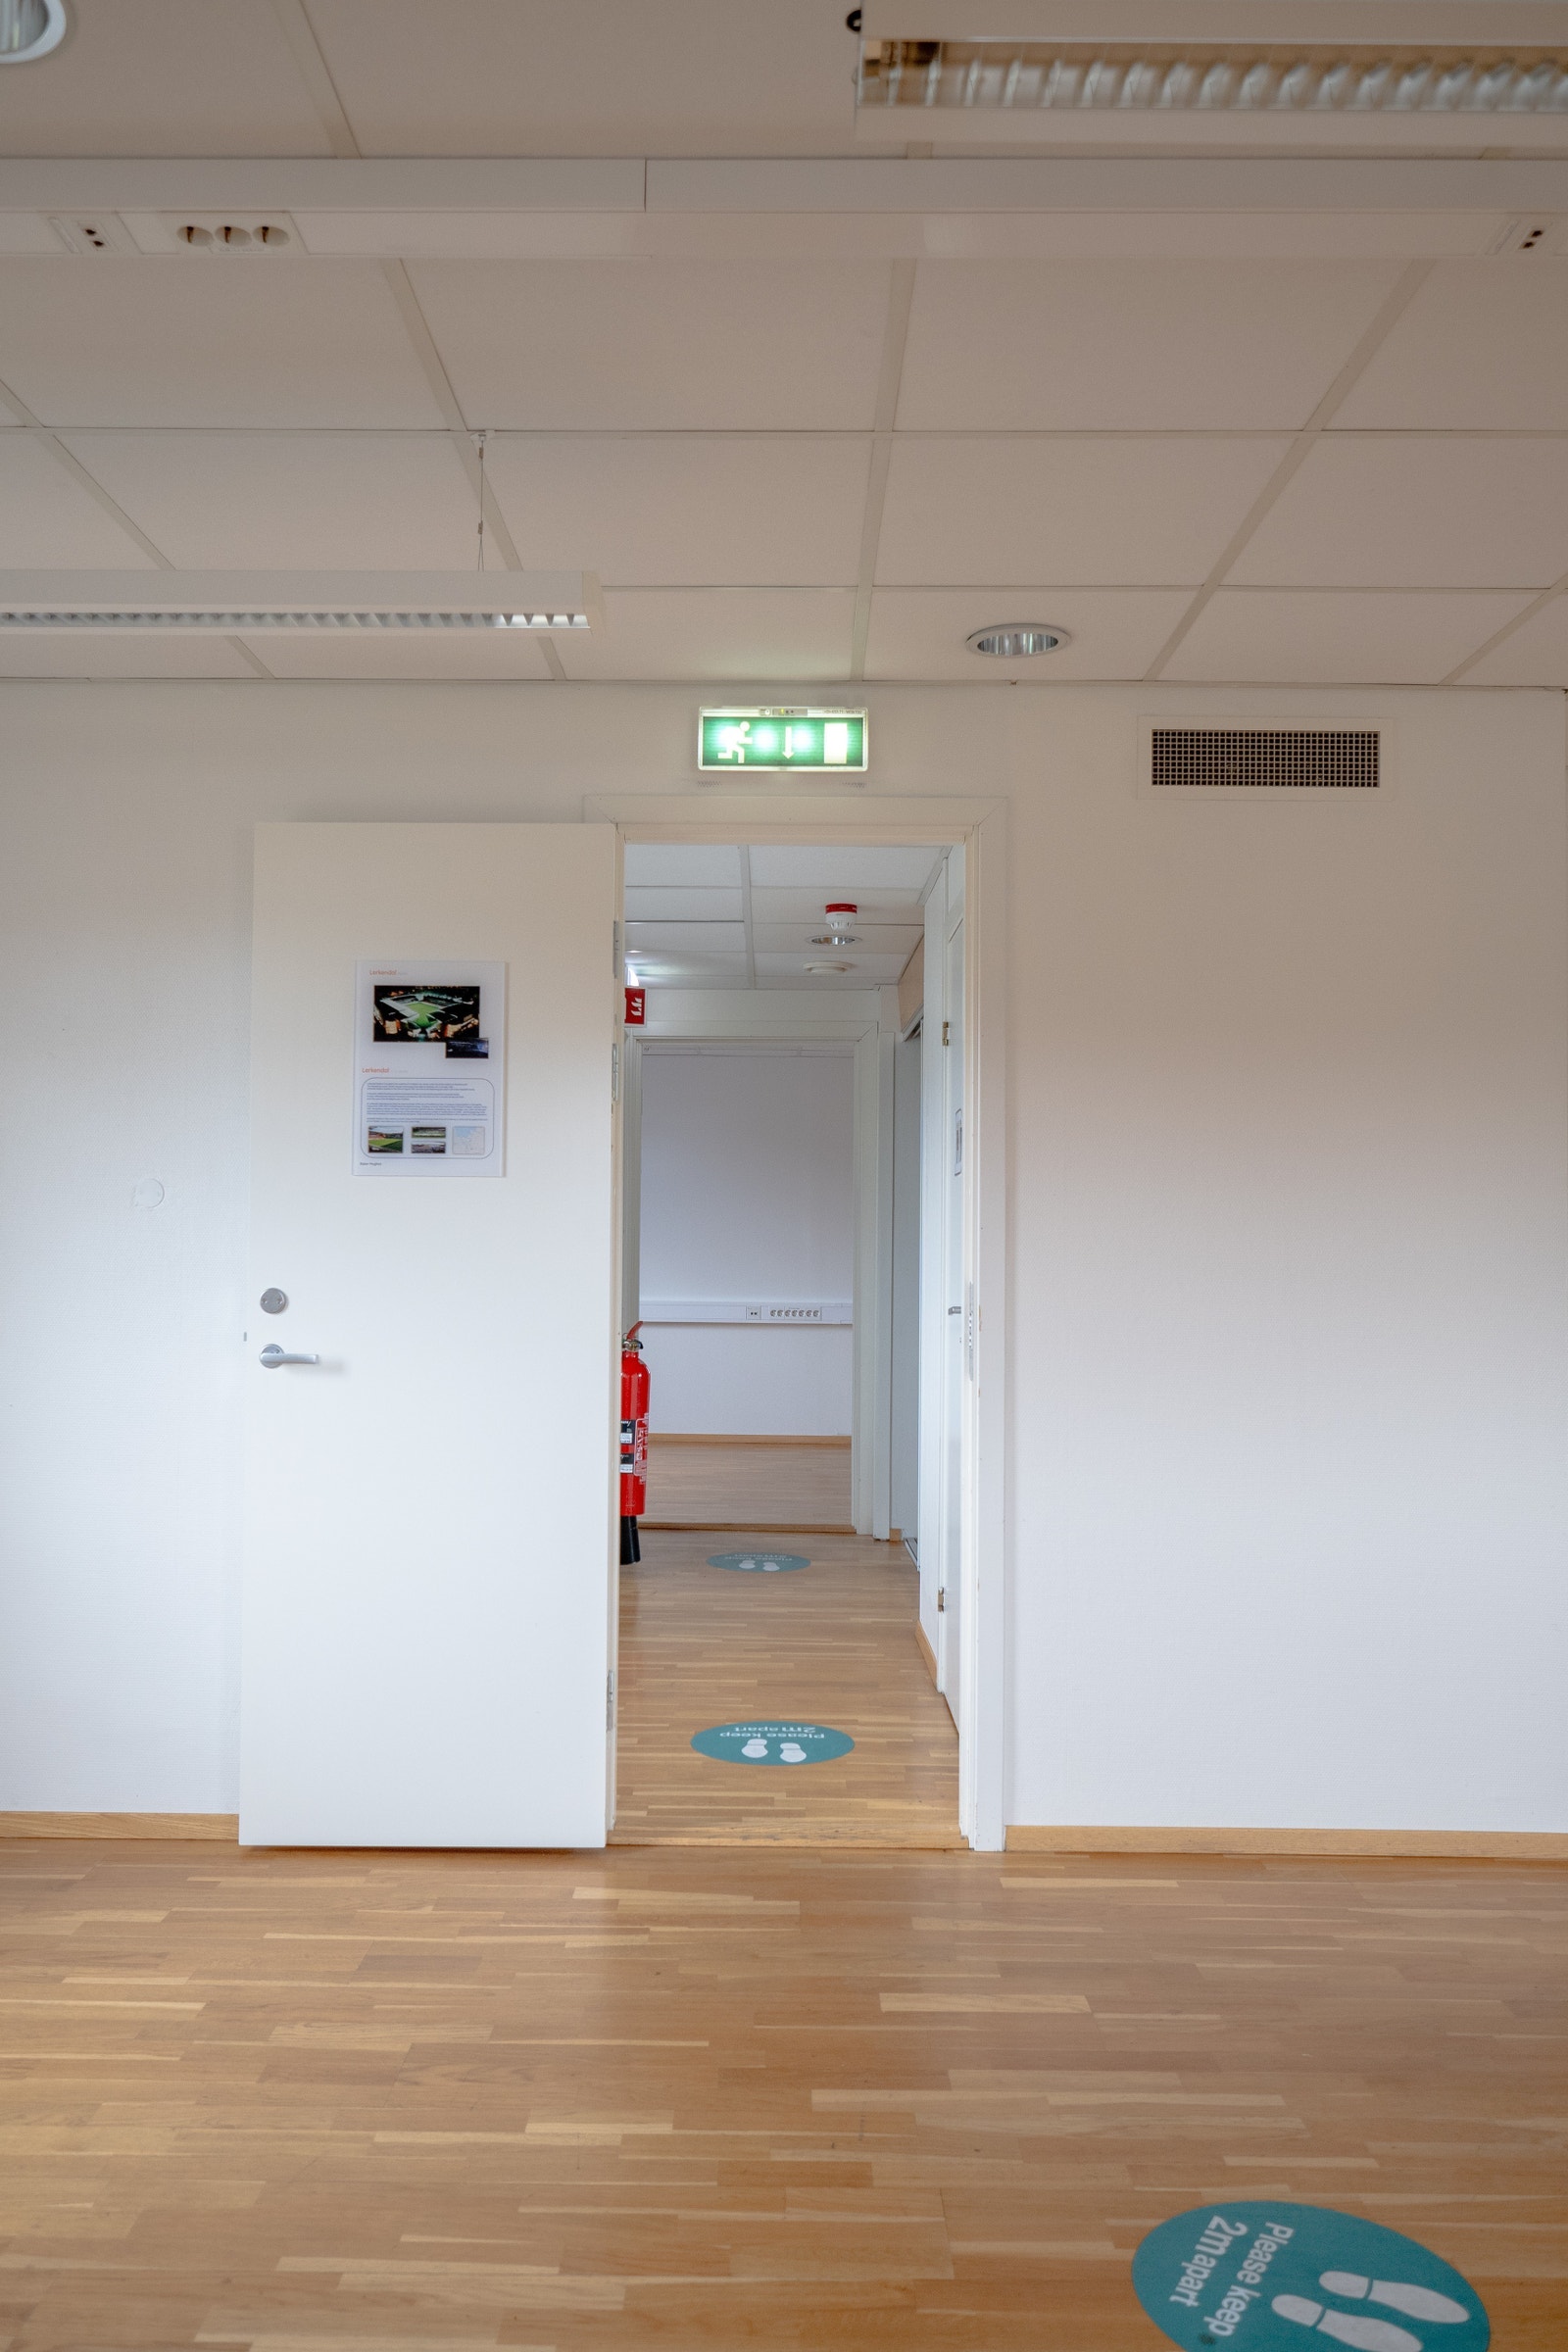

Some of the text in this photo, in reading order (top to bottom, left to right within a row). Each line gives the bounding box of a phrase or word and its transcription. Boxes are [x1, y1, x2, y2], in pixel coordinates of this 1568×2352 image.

[1169, 2215, 1248, 2307] 2m apart
[1202, 2222, 1295, 2336] Please keep
